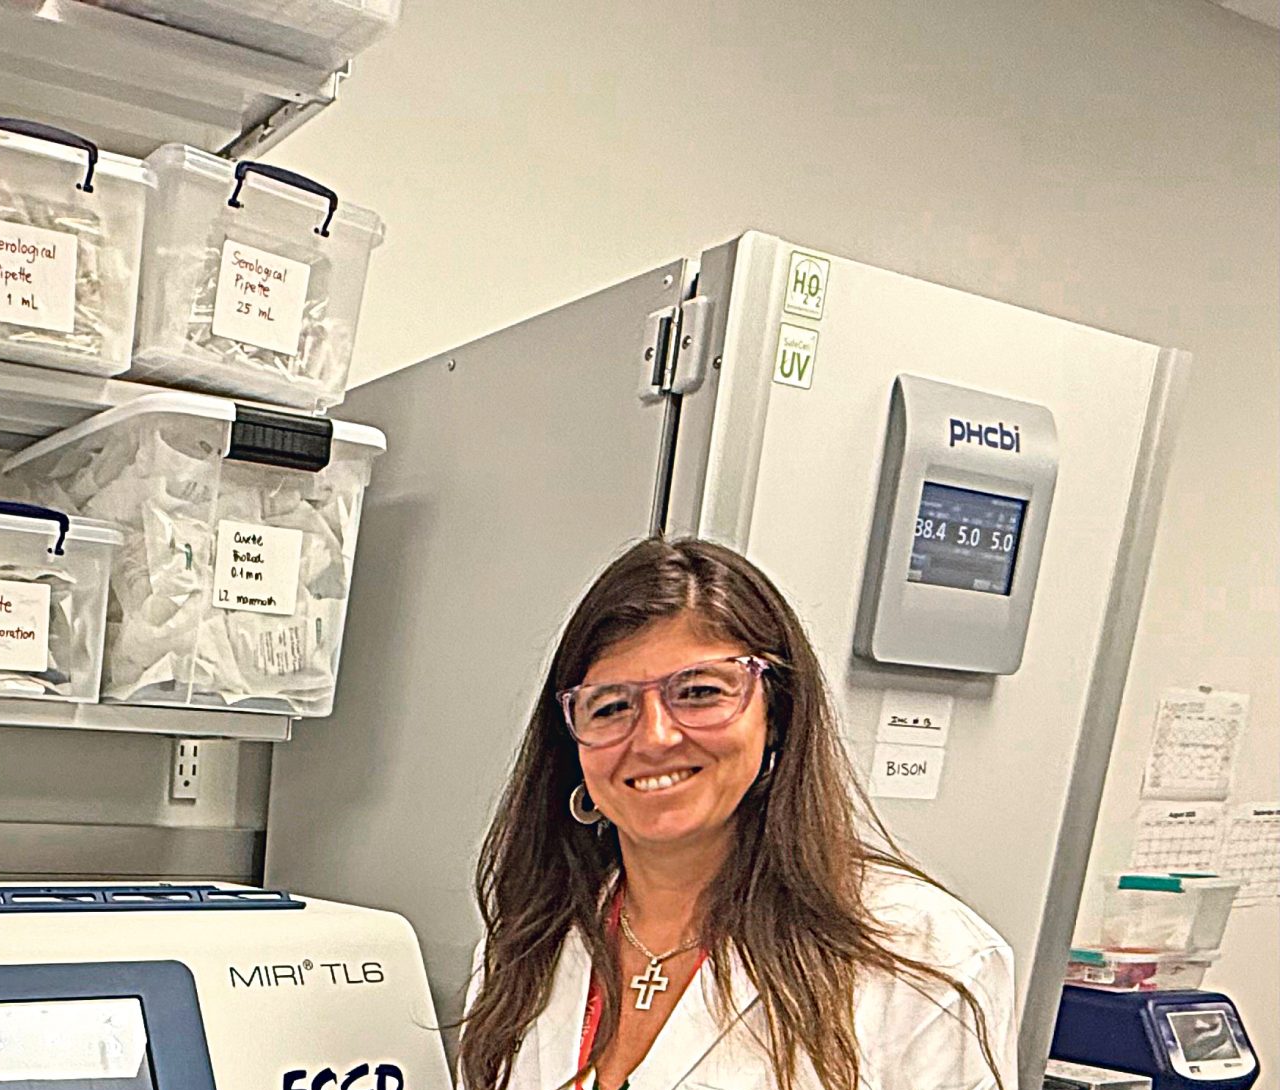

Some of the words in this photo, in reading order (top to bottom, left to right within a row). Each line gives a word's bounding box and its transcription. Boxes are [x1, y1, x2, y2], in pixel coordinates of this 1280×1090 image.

[232, 250, 287, 282] Serological
[234, 273, 270, 297] Pipette
[7, 293, 12, 305] 1
[236, 301, 252, 314] 25
[780, 349, 811, 381] UV
[915, 518, 947, 541] 38.4
[957, 526, 980, 546] 5.0
[990, 531, 1013, 552] 5.0
[886, 761, 927, 777] BISON
[320, 962, 384, 985] TL6
